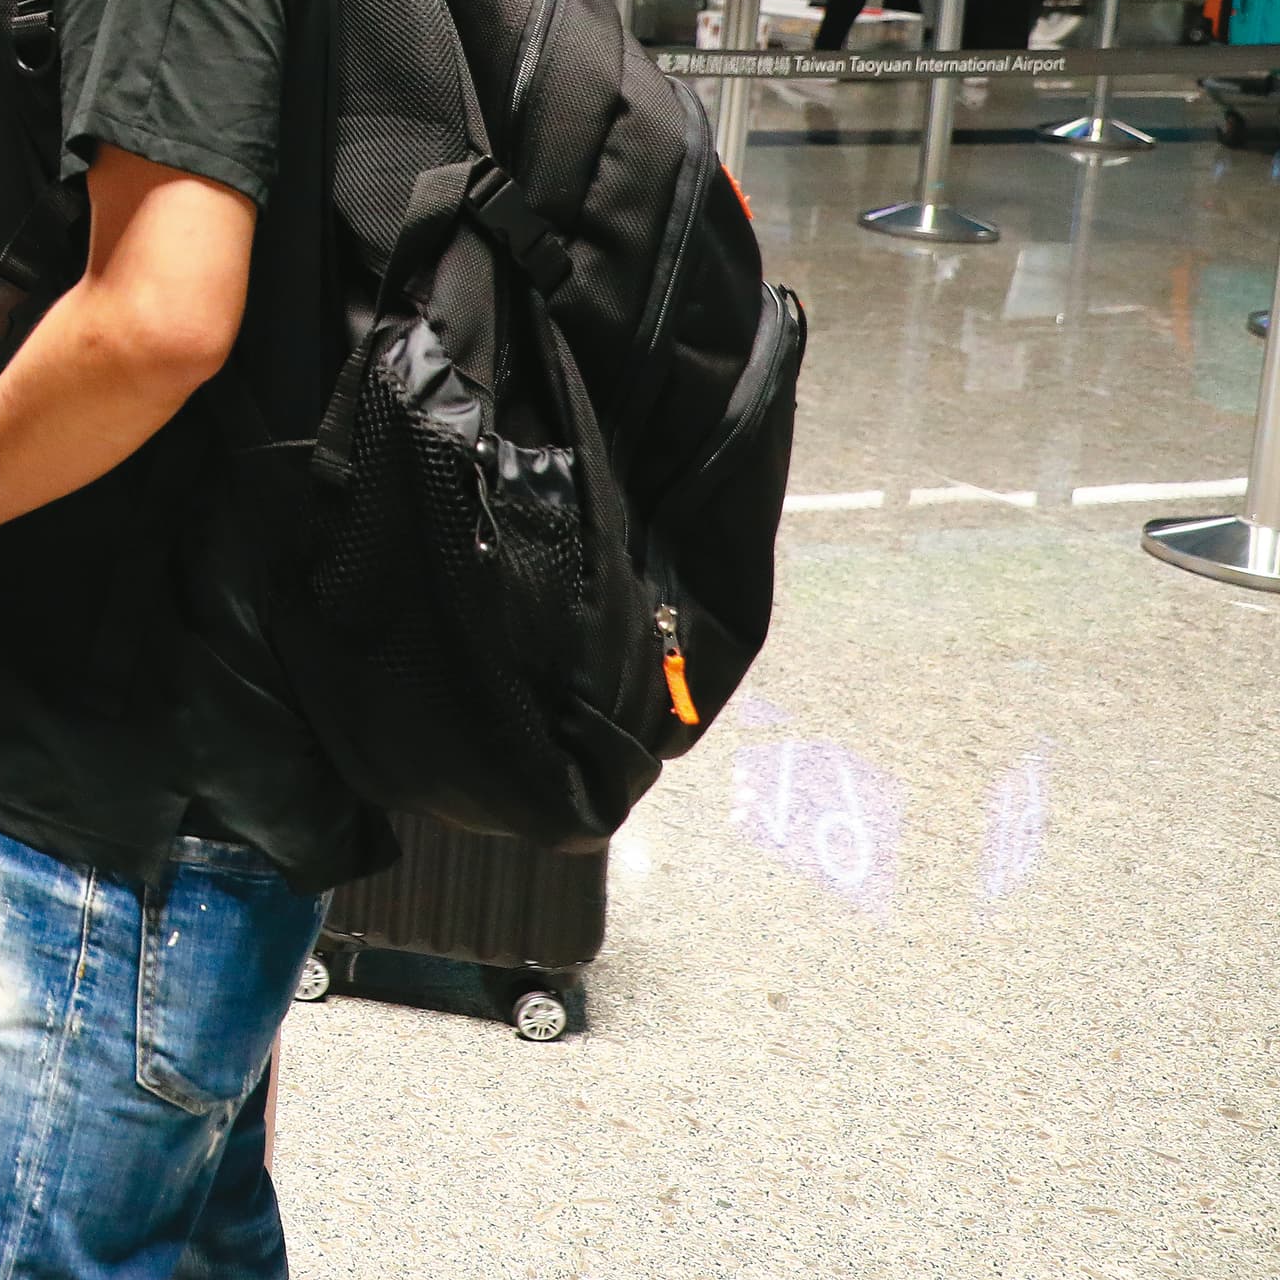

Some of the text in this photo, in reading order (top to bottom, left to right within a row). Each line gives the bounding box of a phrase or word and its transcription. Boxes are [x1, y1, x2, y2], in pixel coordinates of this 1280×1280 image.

[795, 55, 845, 73] Taiwan
[850, 57, 911, 76] Taoyuan
[915, 56, 1009, 74] International
[1011, 56, 1065, 75] Airport
